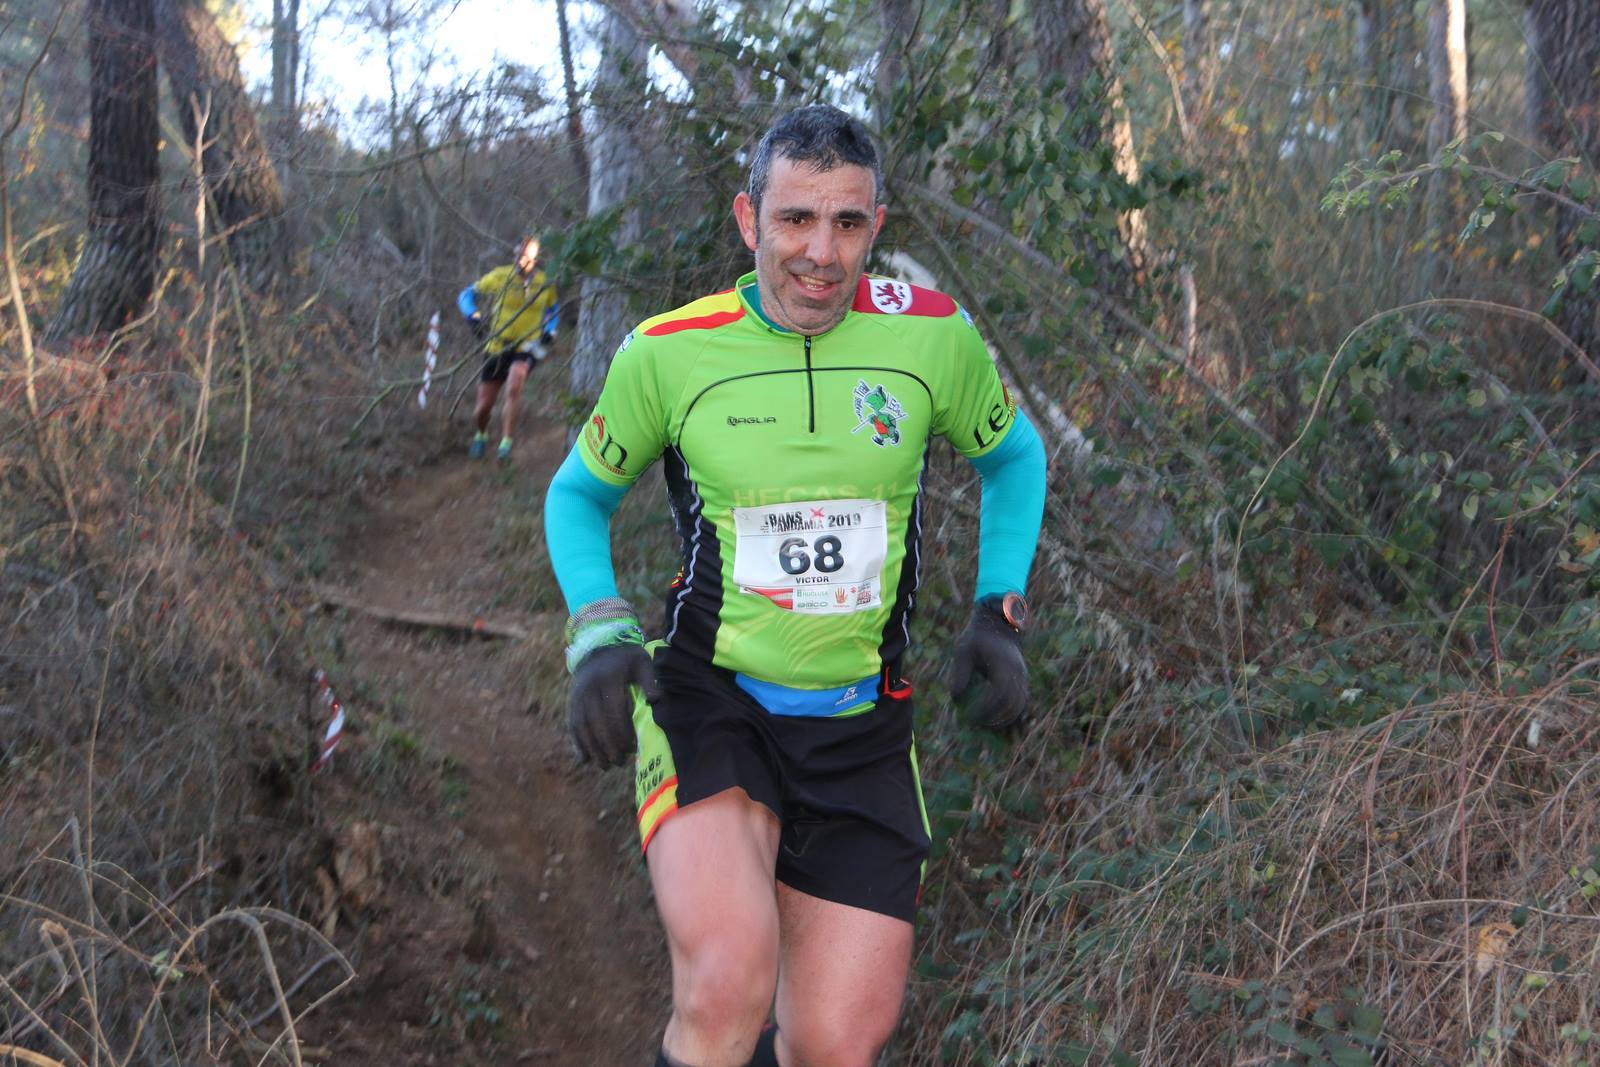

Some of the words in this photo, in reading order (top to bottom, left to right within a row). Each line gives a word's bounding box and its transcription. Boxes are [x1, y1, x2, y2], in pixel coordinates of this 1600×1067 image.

[828, 512, 862, 528] 2019
[778, 534, 845, 576] 68
[795, 575, 830, 584] VICTOR
